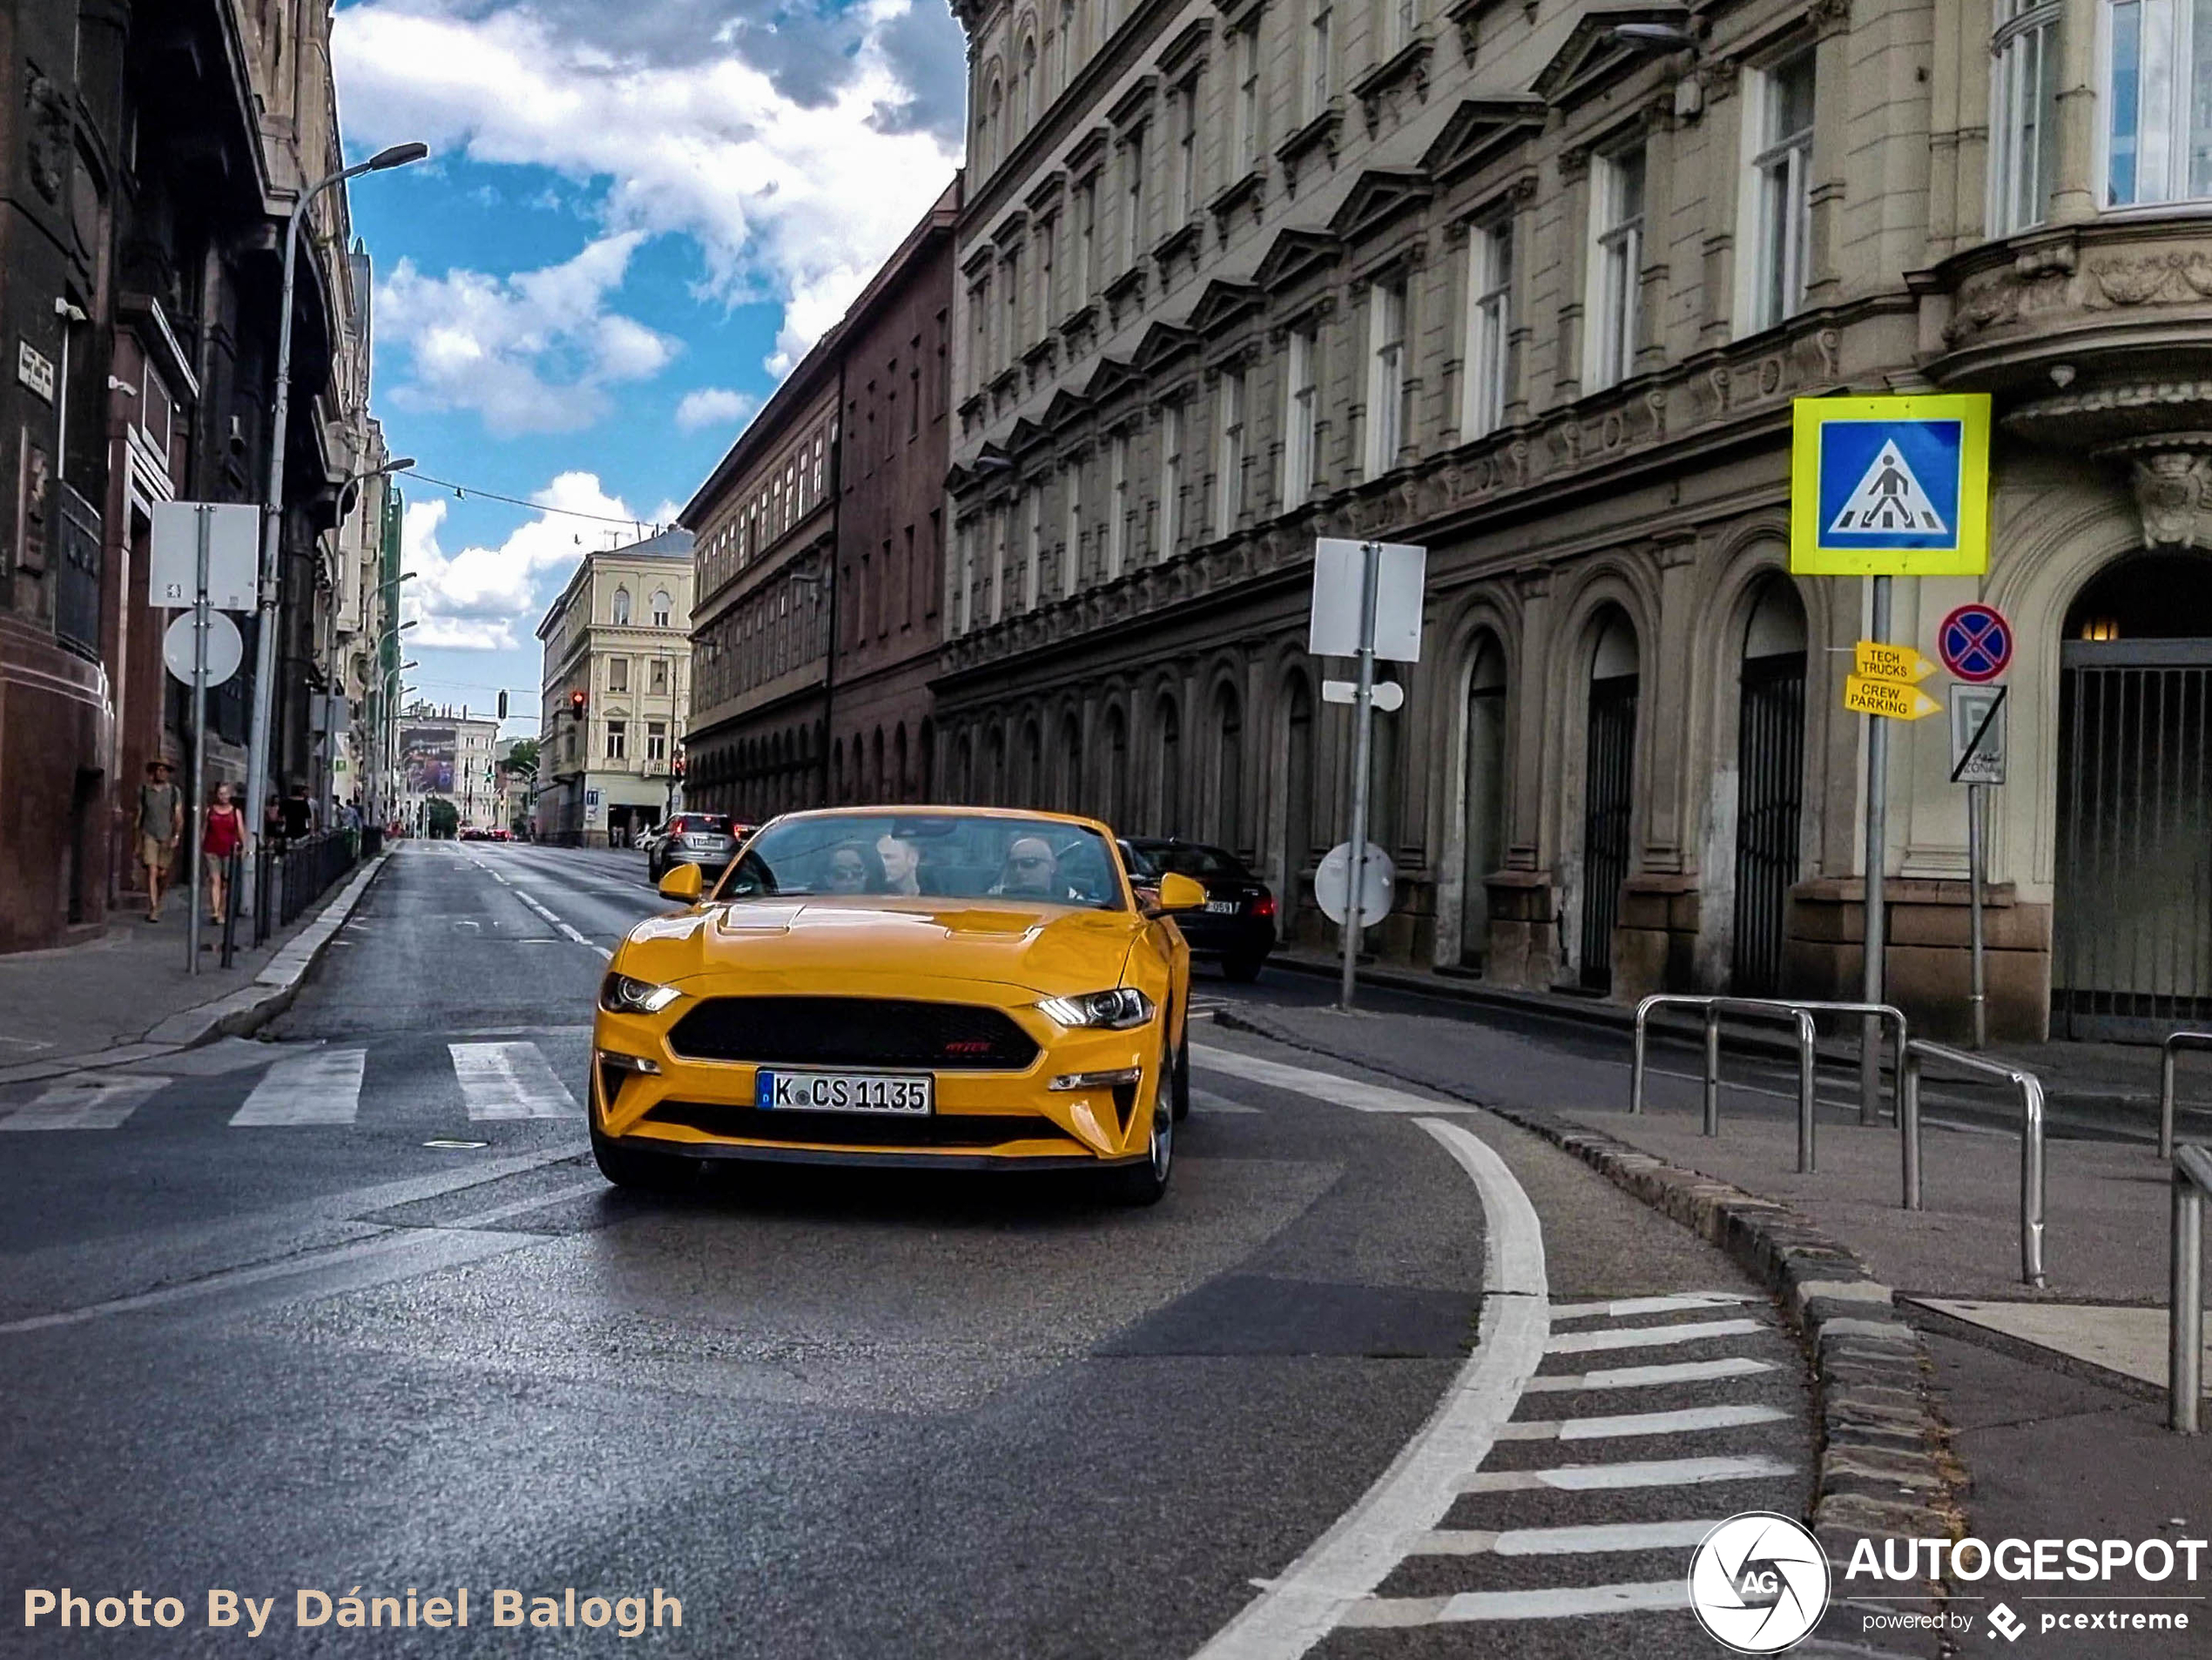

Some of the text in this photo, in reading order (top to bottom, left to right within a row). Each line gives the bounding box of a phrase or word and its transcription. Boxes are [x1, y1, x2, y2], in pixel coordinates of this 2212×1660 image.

[1871, 650, 1899, 663] TECH
[1862, 661, 1907, 678] TRUCKS
[1862, 683, 1900, 700] CREW
[1851, 694, 1907, 714] PARKING
[776, 1078, 792, 1105] K
[813, 1079, 849, 1107] CS
[855, 1081, 925, 1109] 1135
